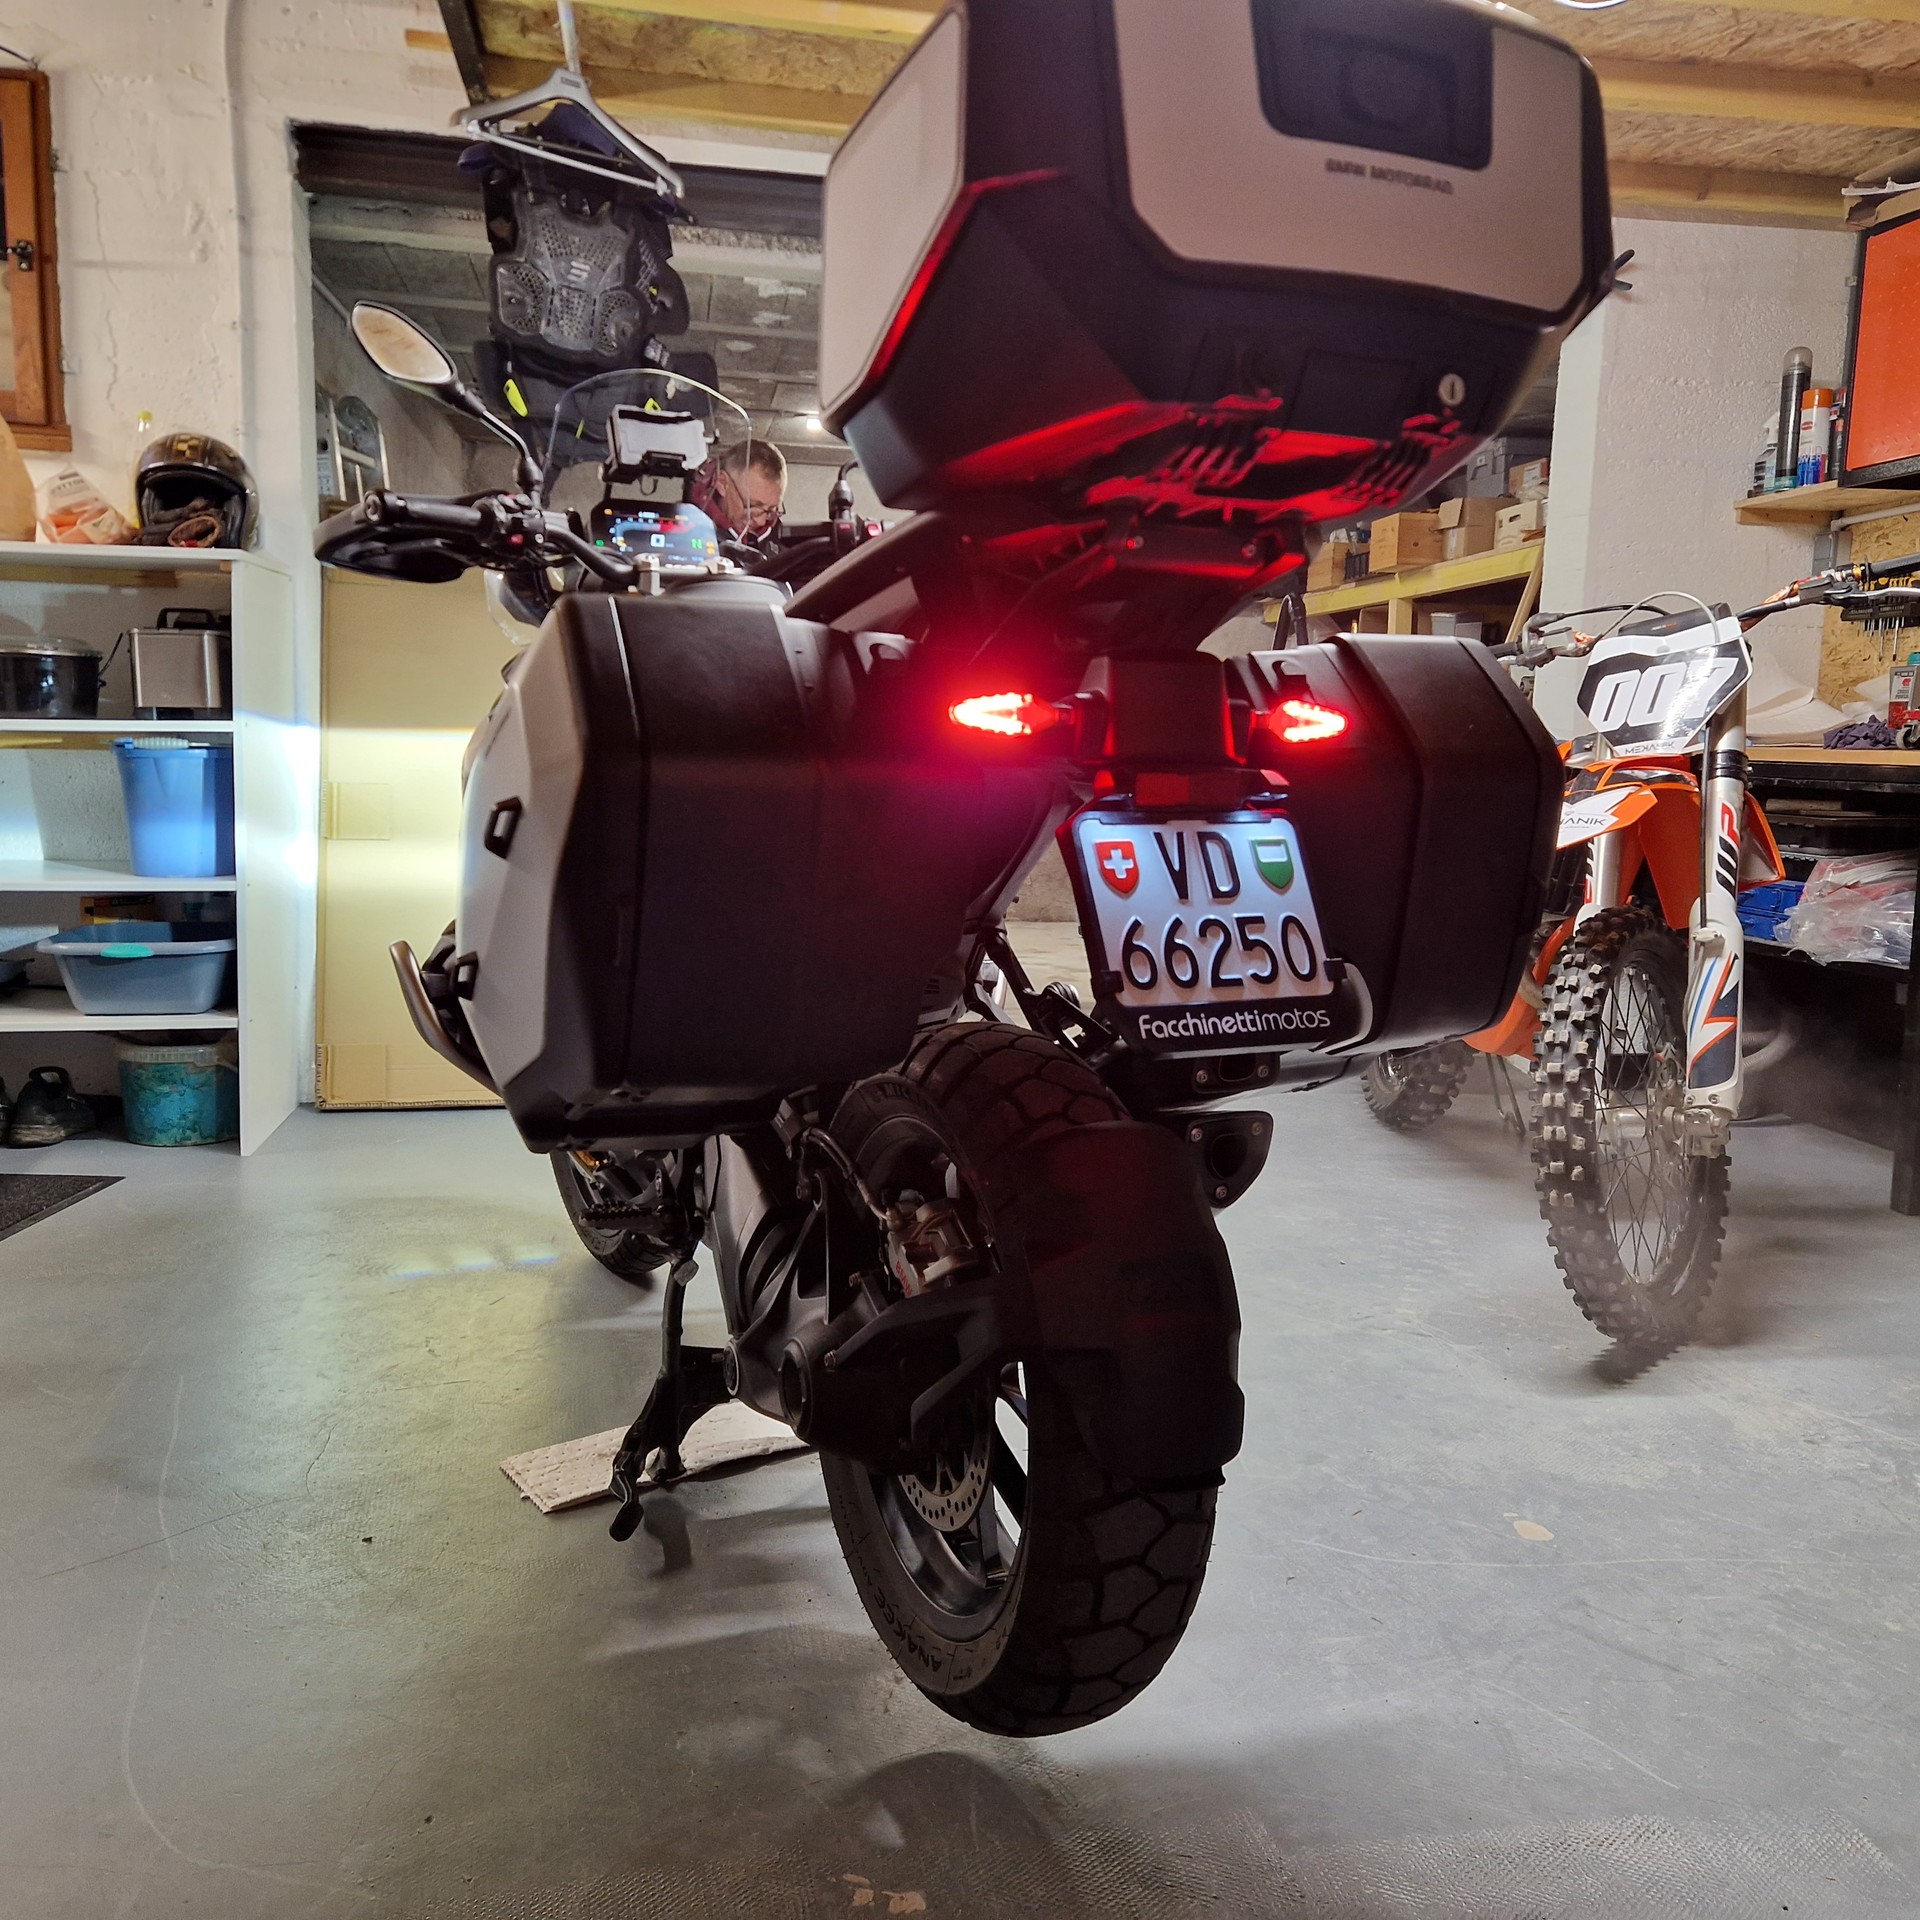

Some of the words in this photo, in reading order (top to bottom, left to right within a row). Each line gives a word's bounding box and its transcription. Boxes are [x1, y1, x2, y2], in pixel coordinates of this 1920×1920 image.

[1325, 158, 1366, 177] BMW
[1369, 165, 1454, 195] MOTORRAD
[1589, 657, 1739, 733] 007
[1625, 741, 1674, 755] MEKAK
[1153, 831, 1242, 901] VD
[1121, 914, 1318, 990] 66250
[1138, 1008, 1331, 1040] Facchinettimotos
[873, 1586, 942, 1673] ANAKEE
